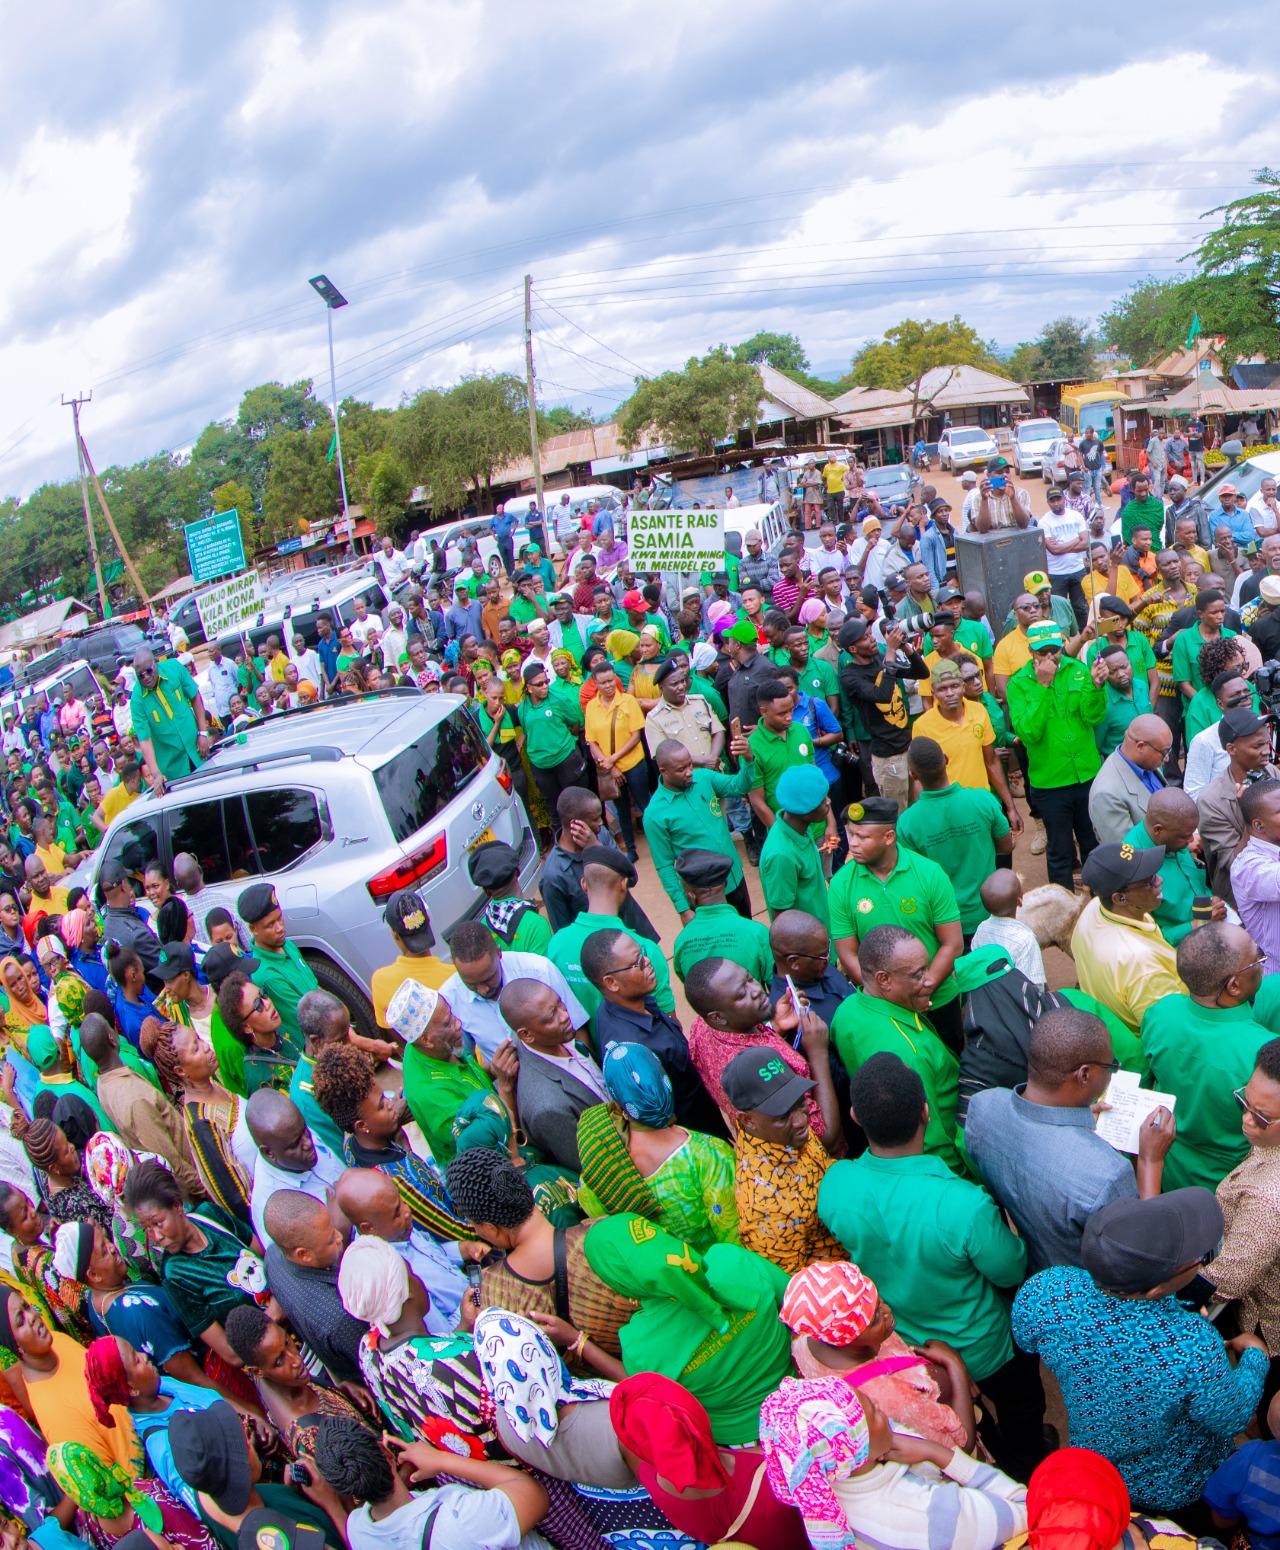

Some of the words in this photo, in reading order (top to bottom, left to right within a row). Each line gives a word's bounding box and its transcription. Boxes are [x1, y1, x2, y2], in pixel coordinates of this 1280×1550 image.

[631, 514, 683, 530] ASANTE
[687, 514, 718, 528] RAIS
[633, 532, 694, 549] SAMIA
[631, 551, 657, 559] KWA
[659, 551, 696, 559] MIRADI
[696, 550, 725, 559] MINGI
[635, 561, 646, 571] YA
[651, 560, 716, 571] MAENDELEO
[199, 588, 225, 609] VUNJO
[227, 572, 257, 596] MIRADI
[202, 604, 223, 623] KILA
[226, 588, 254, 611] KONA
[207, 610, 239, 637] ASANTE
